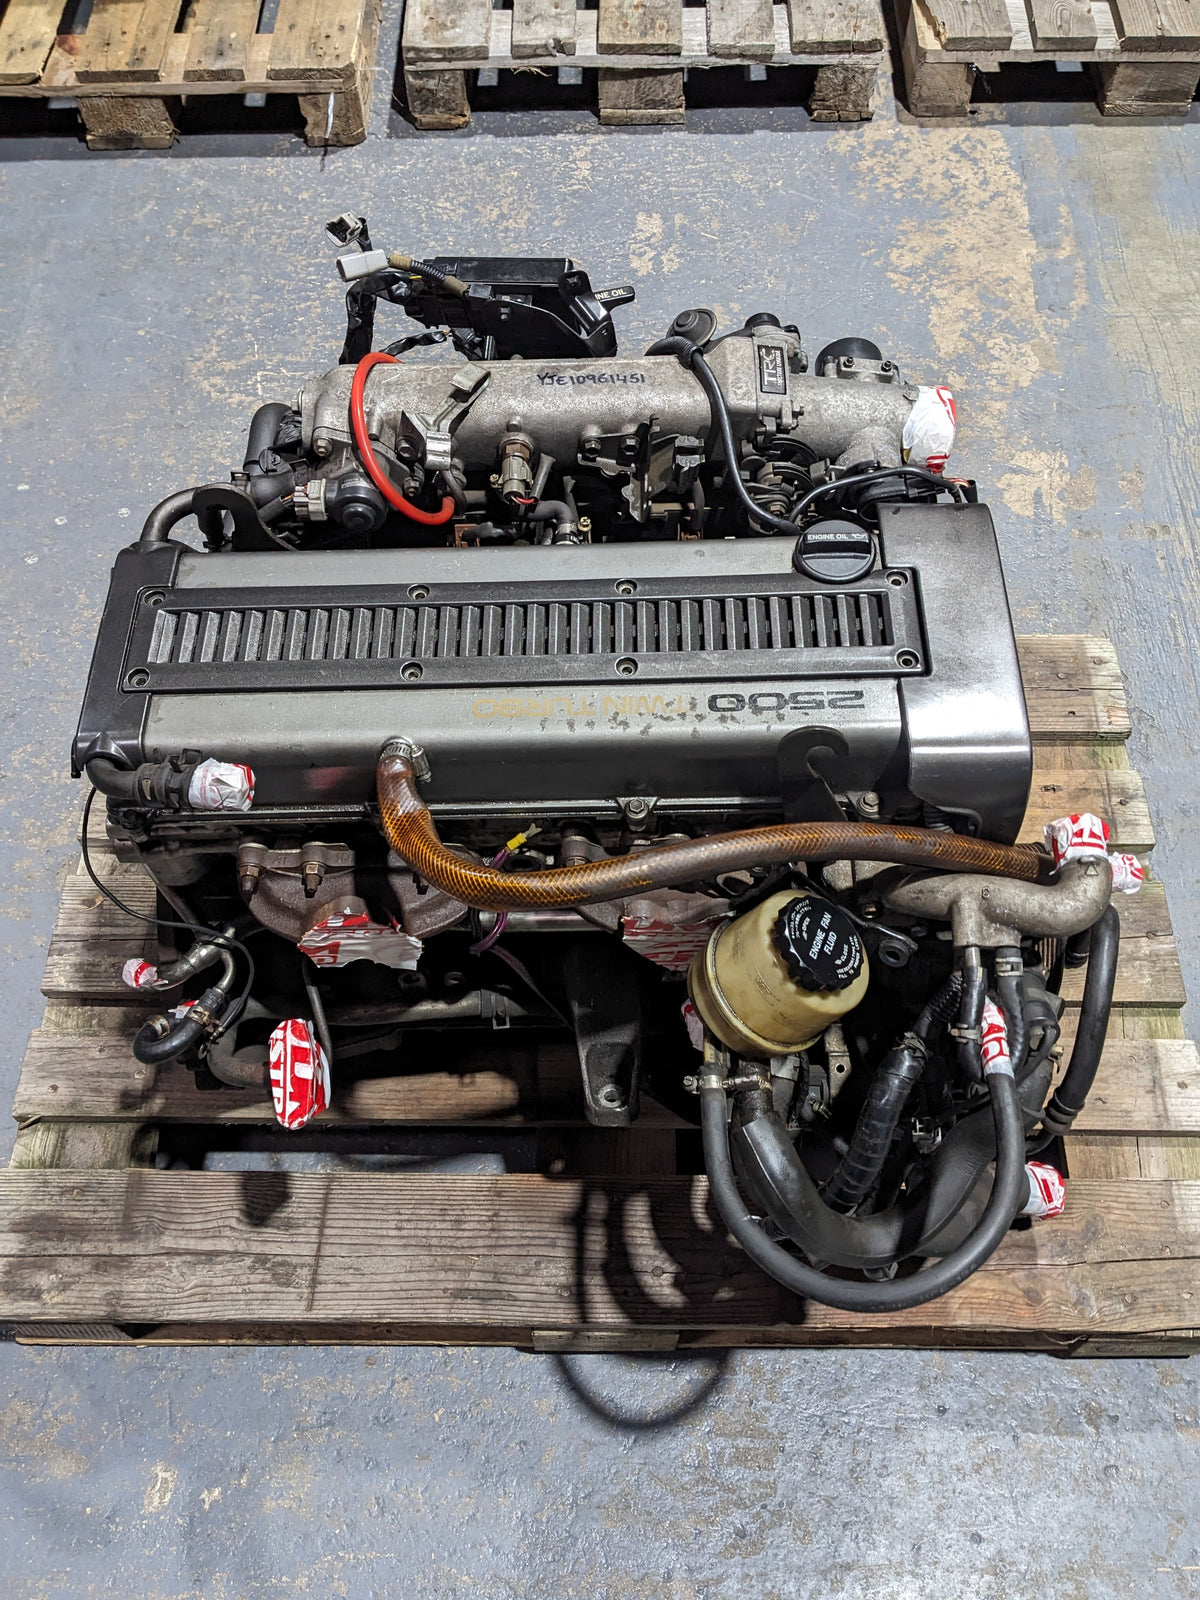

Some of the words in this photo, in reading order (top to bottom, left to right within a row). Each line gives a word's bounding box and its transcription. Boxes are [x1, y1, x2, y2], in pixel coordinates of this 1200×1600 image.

[611, 288, 627, 297] OIL
[760, 348, 777, 386] TRC
[471, 696, 596, 719] TURBO
[707, 689, 865, 715] 2500
[809, 928, 826, 960] ENGINE
[820, 911, 833, 930] FAN
[823, 931, 838, 956] FLUID
